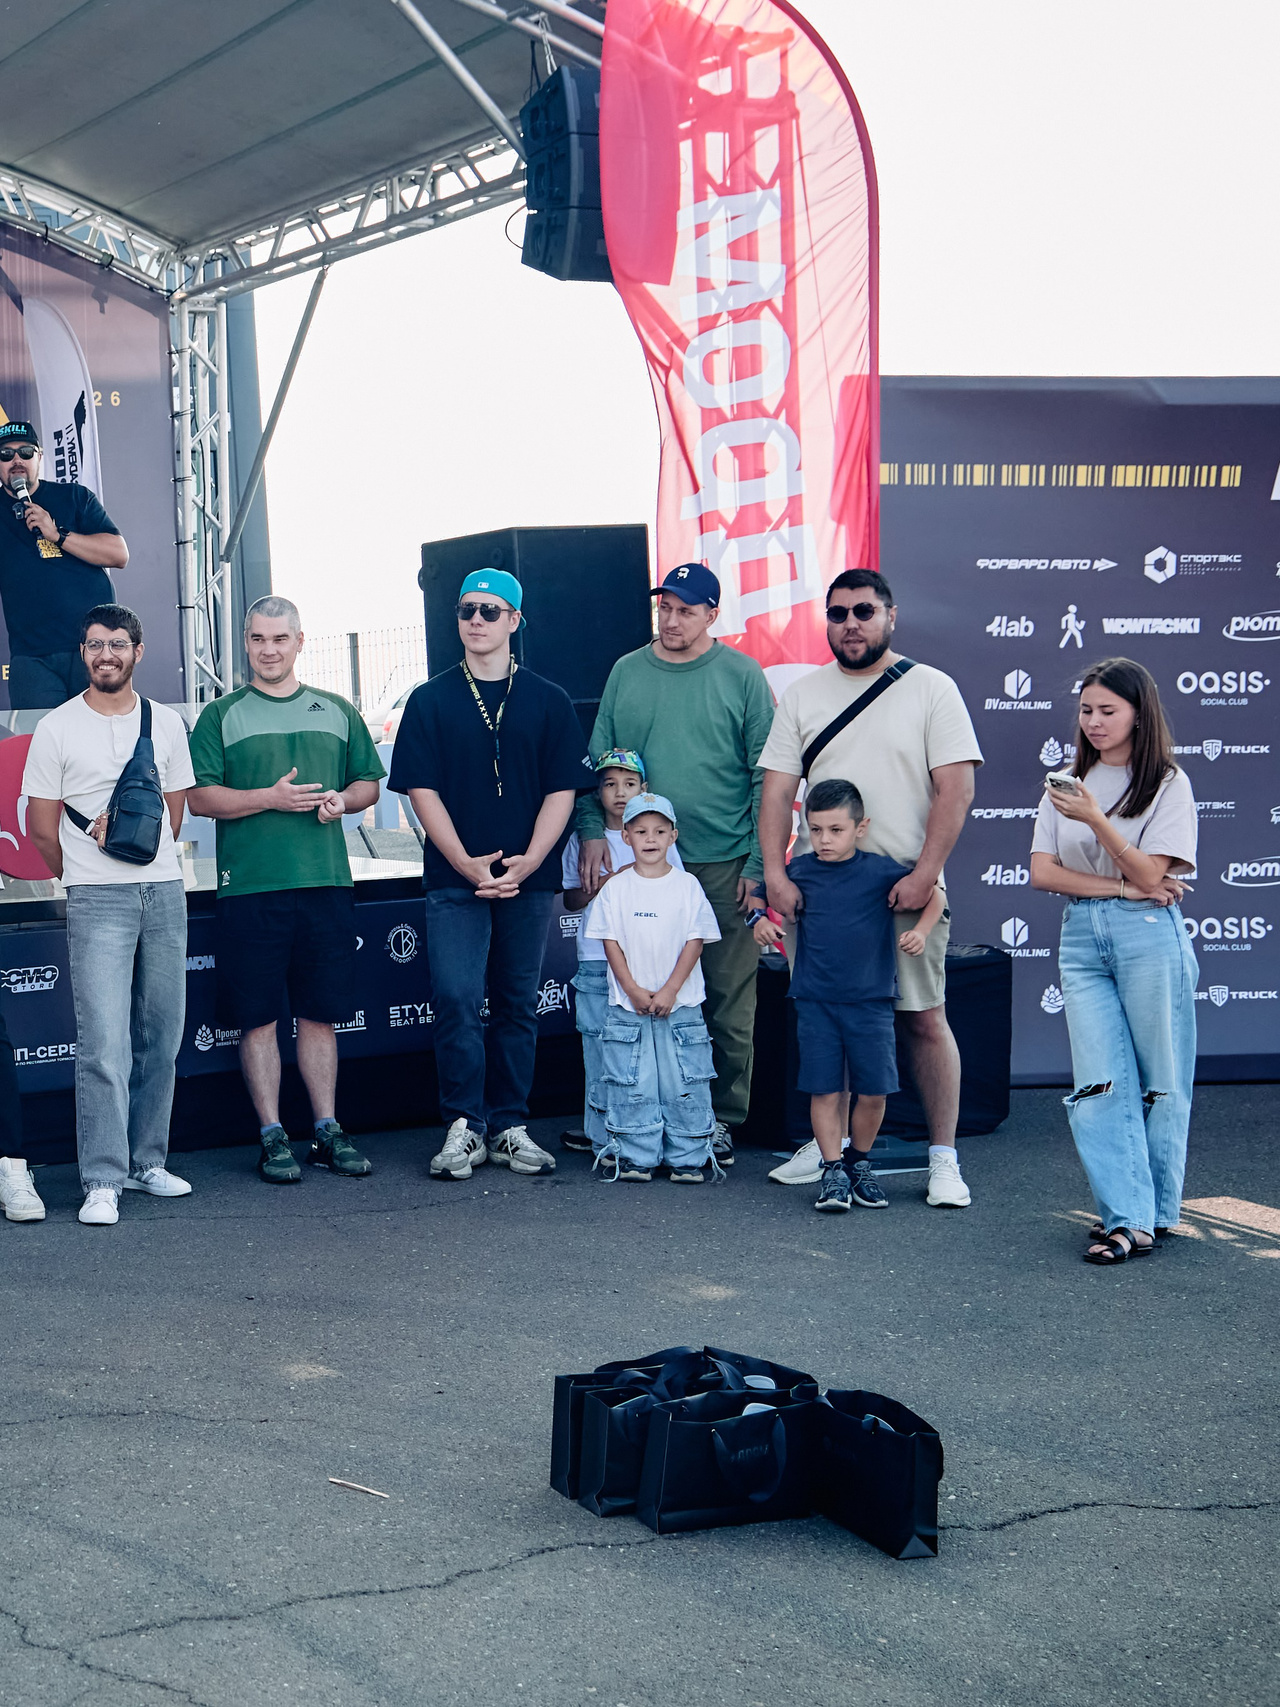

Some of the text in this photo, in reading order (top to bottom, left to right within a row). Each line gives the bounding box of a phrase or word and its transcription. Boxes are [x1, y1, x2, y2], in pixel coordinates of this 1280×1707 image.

[1200, 698, 1249, 706] SOCIAL CLUB
[1222, 744, 1270, 754] TRUCK
[1203, 943, 1252, 952] SOCIAL CLUB
[12, 981, 54, 993] STORE
[1229, 990, 1278, 1000] TRUCK
[390, 1016, 415, 1027] SEAT
